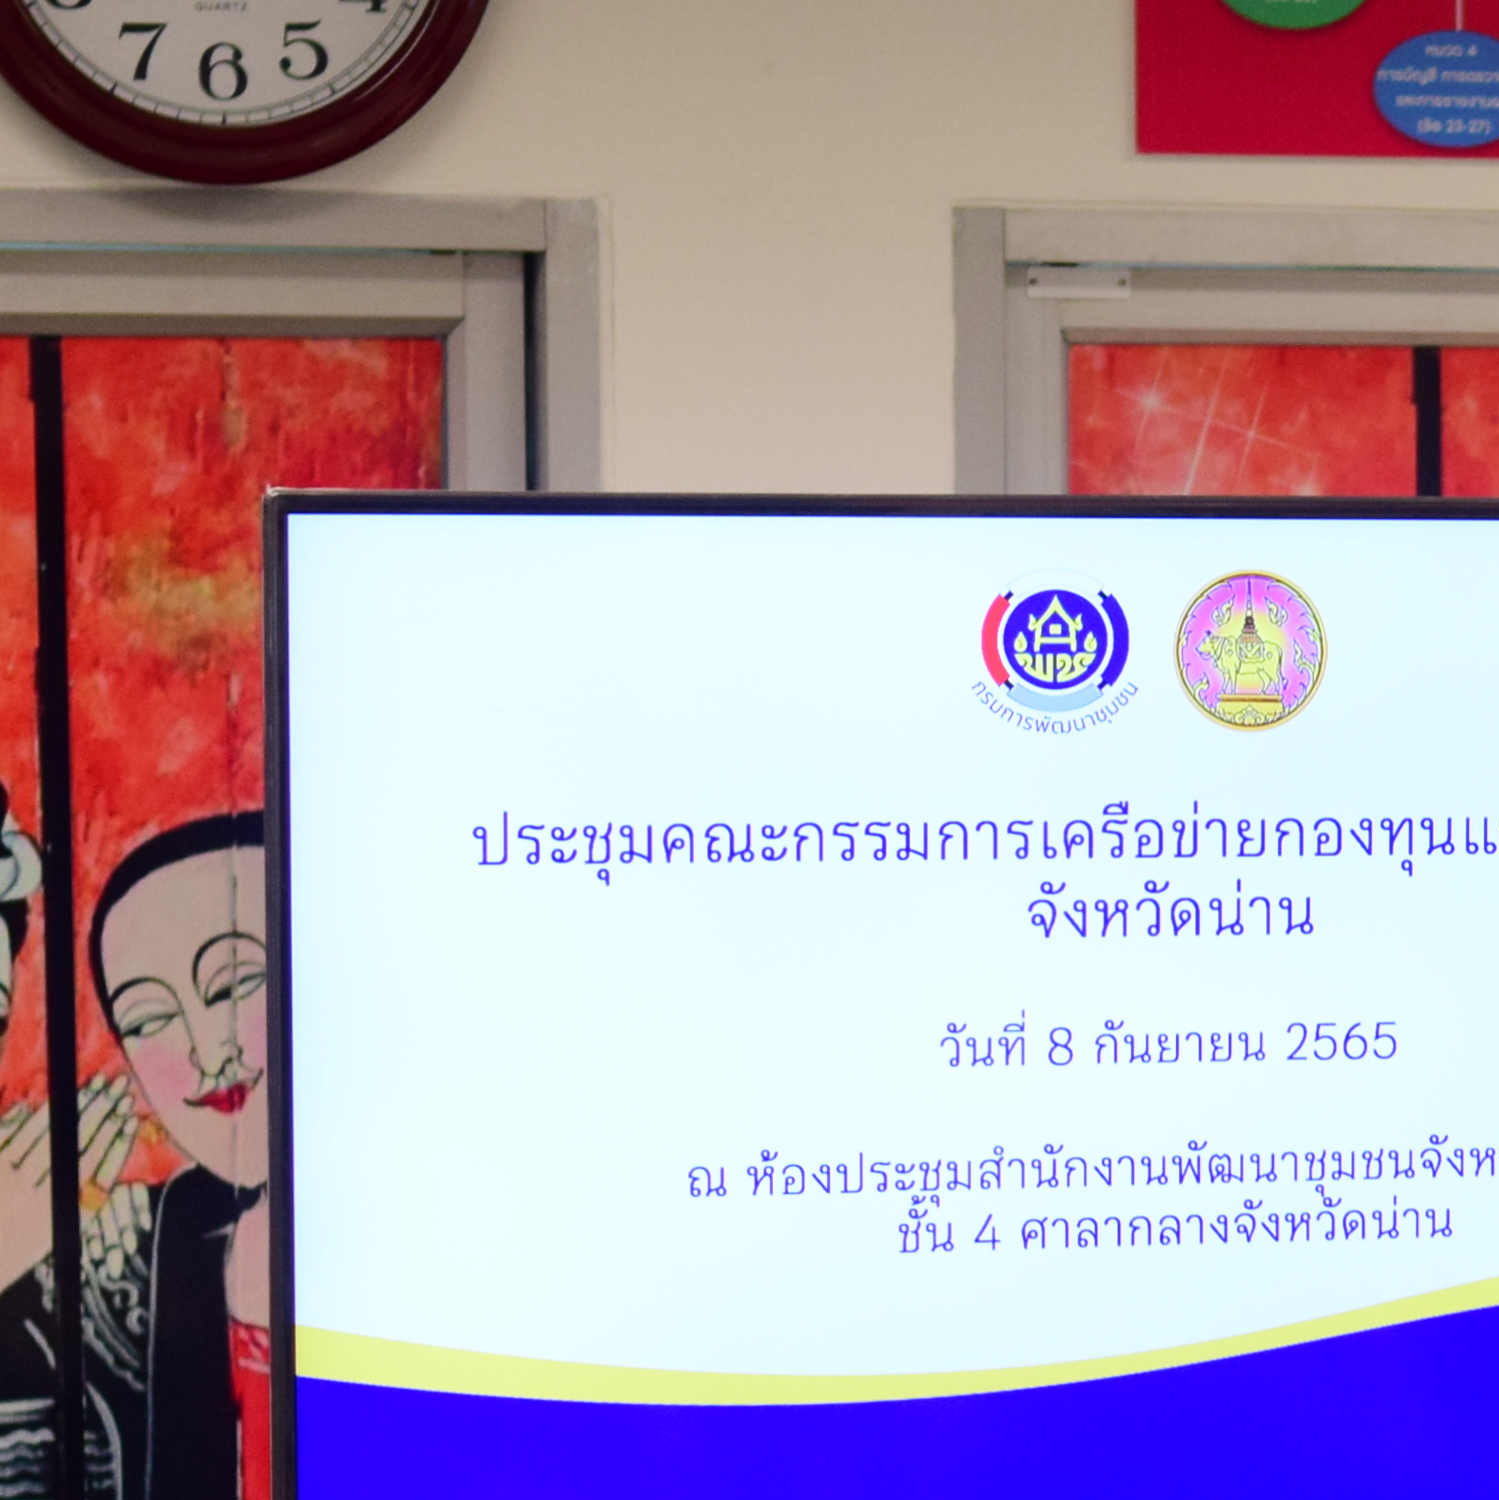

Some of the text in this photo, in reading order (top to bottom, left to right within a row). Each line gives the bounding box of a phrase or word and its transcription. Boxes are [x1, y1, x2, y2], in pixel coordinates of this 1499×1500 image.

[119, 22, 168, 81] 7
[199, 41, 248, 101] 6
[279, 19, 329, 80] 5
[971, 680, 1139, 735] กรมการพัฒนาชุมชน
[1027, 878, 1314, 940] จังหวัดน่าน
[940, 1009, 1398, 1067] วันที่ 8 กันยายน 2565
[688, 1166, 728, 1198] ณ
[898, 1195, 1453, 1253] ชั้น 4 ศาลากลางจังหวัดน่าน
